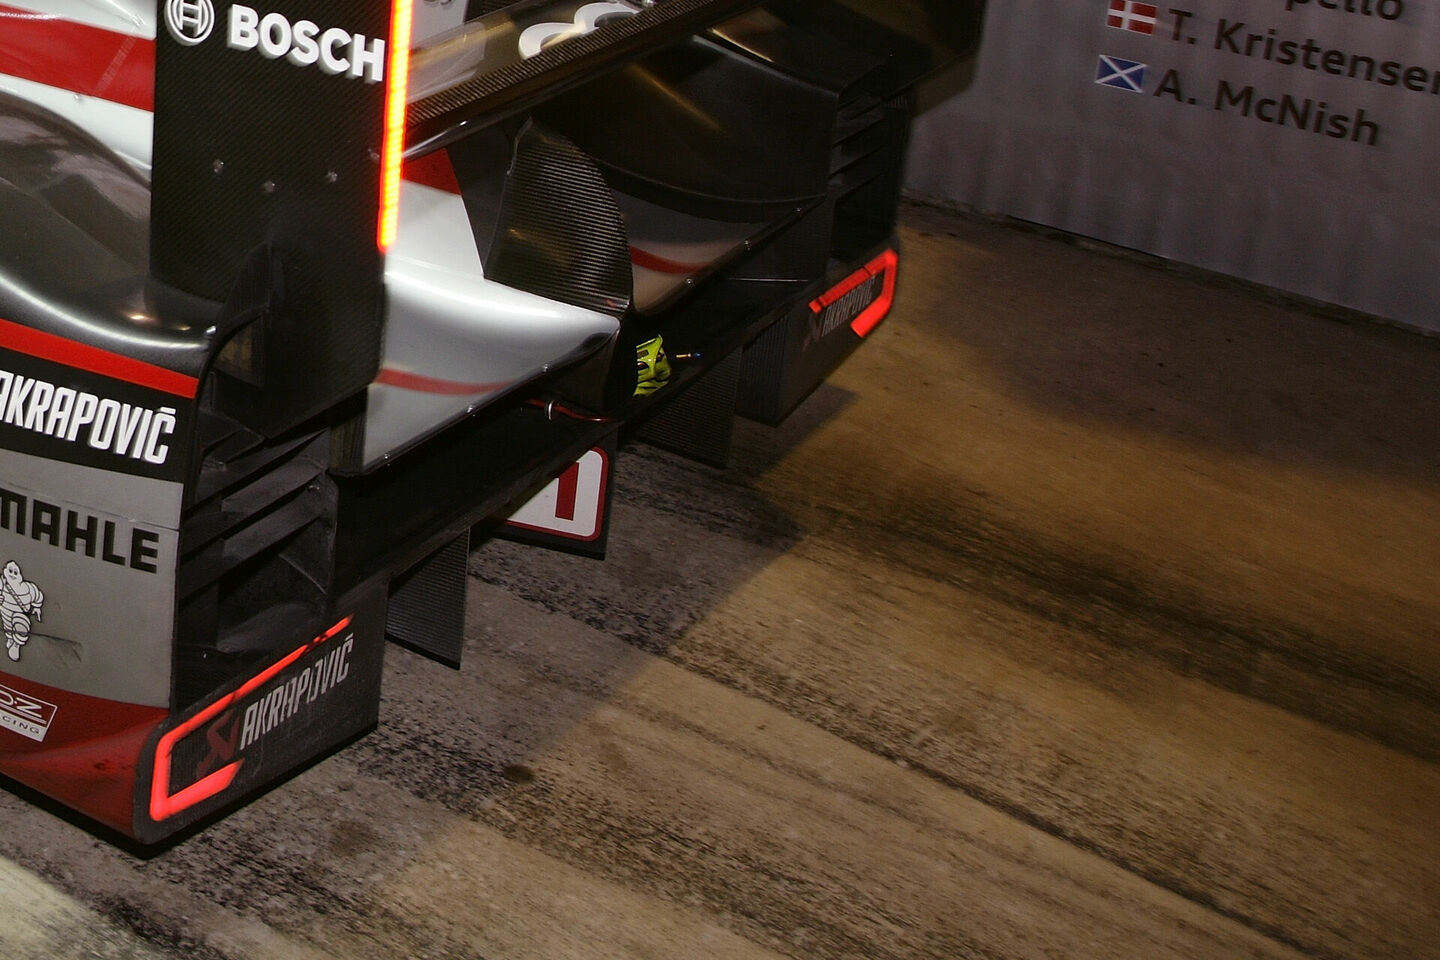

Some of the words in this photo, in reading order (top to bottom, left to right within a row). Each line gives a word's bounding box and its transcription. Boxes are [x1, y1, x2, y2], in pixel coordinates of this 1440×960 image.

[227, 3, 386, 84] BOSCH
[1168, 7, 1197, 46] T.
[1153, 68, 1197, 106] A.
[1214, 79, 1379, 147] McNish
